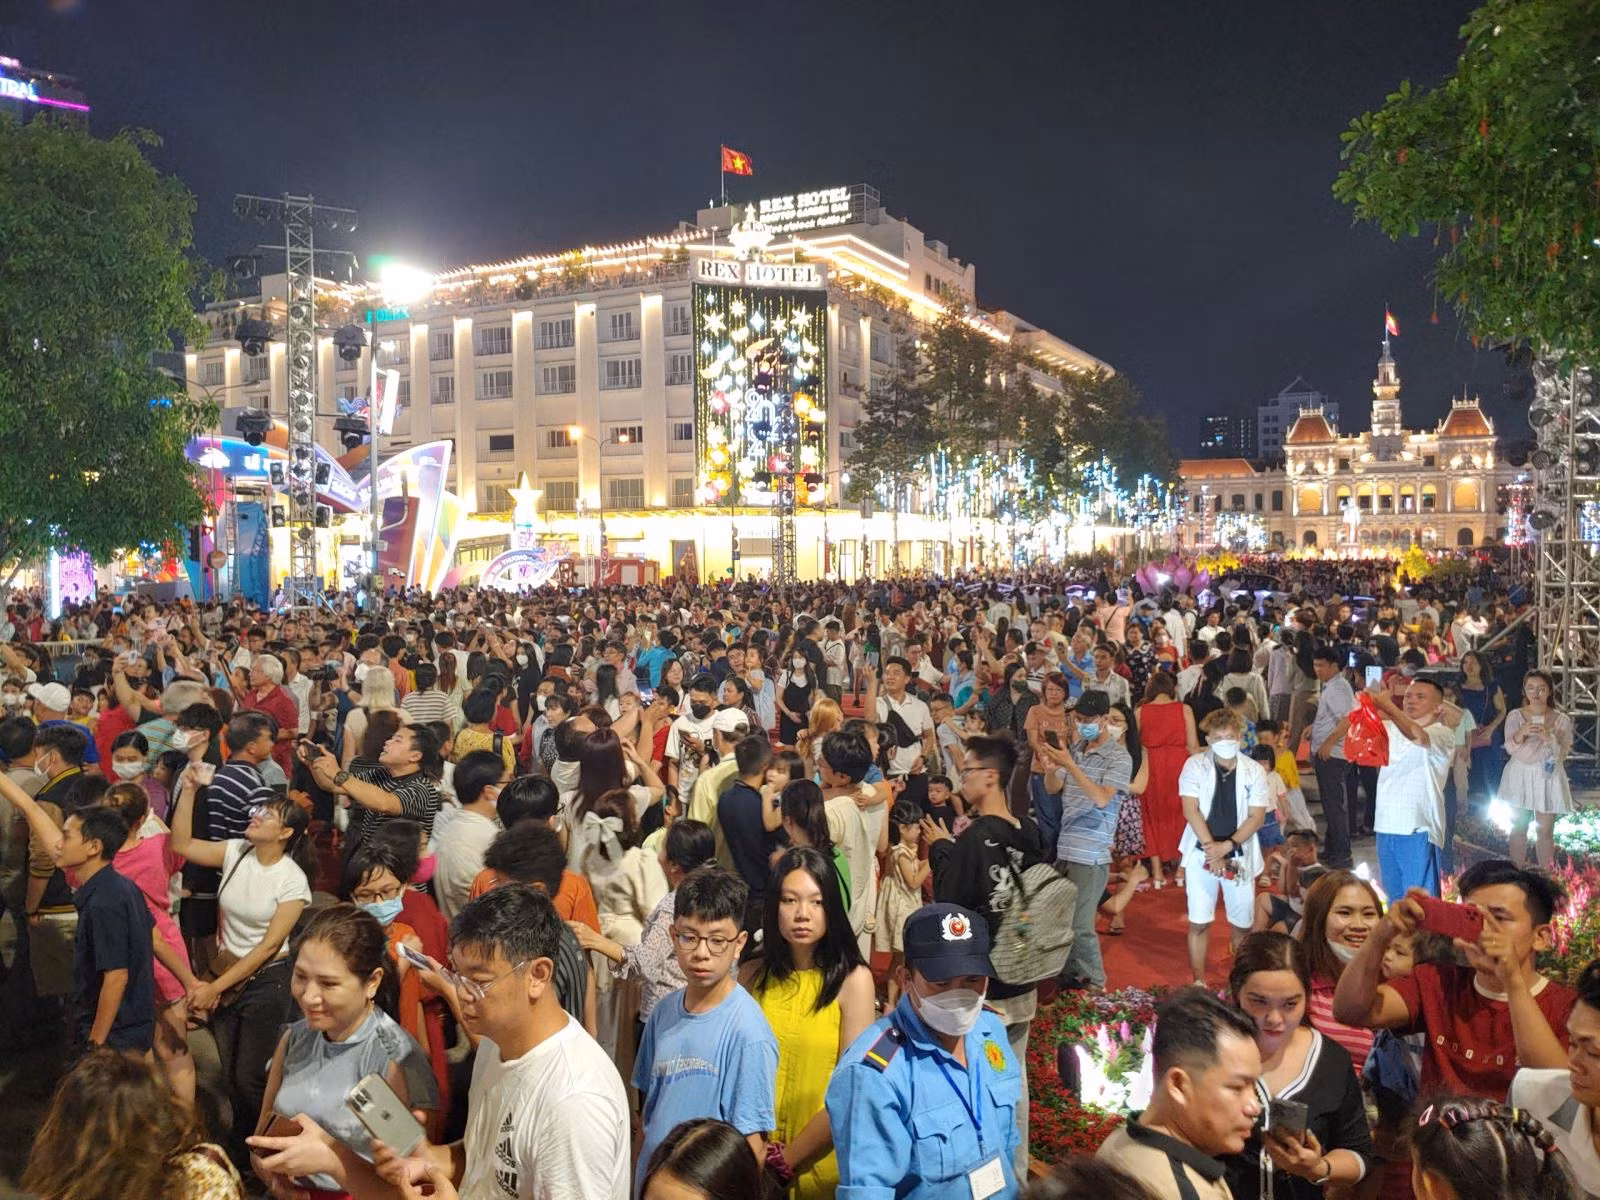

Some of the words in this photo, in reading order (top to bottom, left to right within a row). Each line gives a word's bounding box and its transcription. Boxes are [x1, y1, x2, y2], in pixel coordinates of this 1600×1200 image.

[759, 197, 794, 213] REX
[797, 187, 851, 207] HOTEL
[831, 202, 849, 212] BAR
[701, 260, 739, 279] REX
[748, 265, 819, 282] HOTEL
[494, 1145, 517, 1169] adidas
[494, 1168, 520, 1199] adidas
